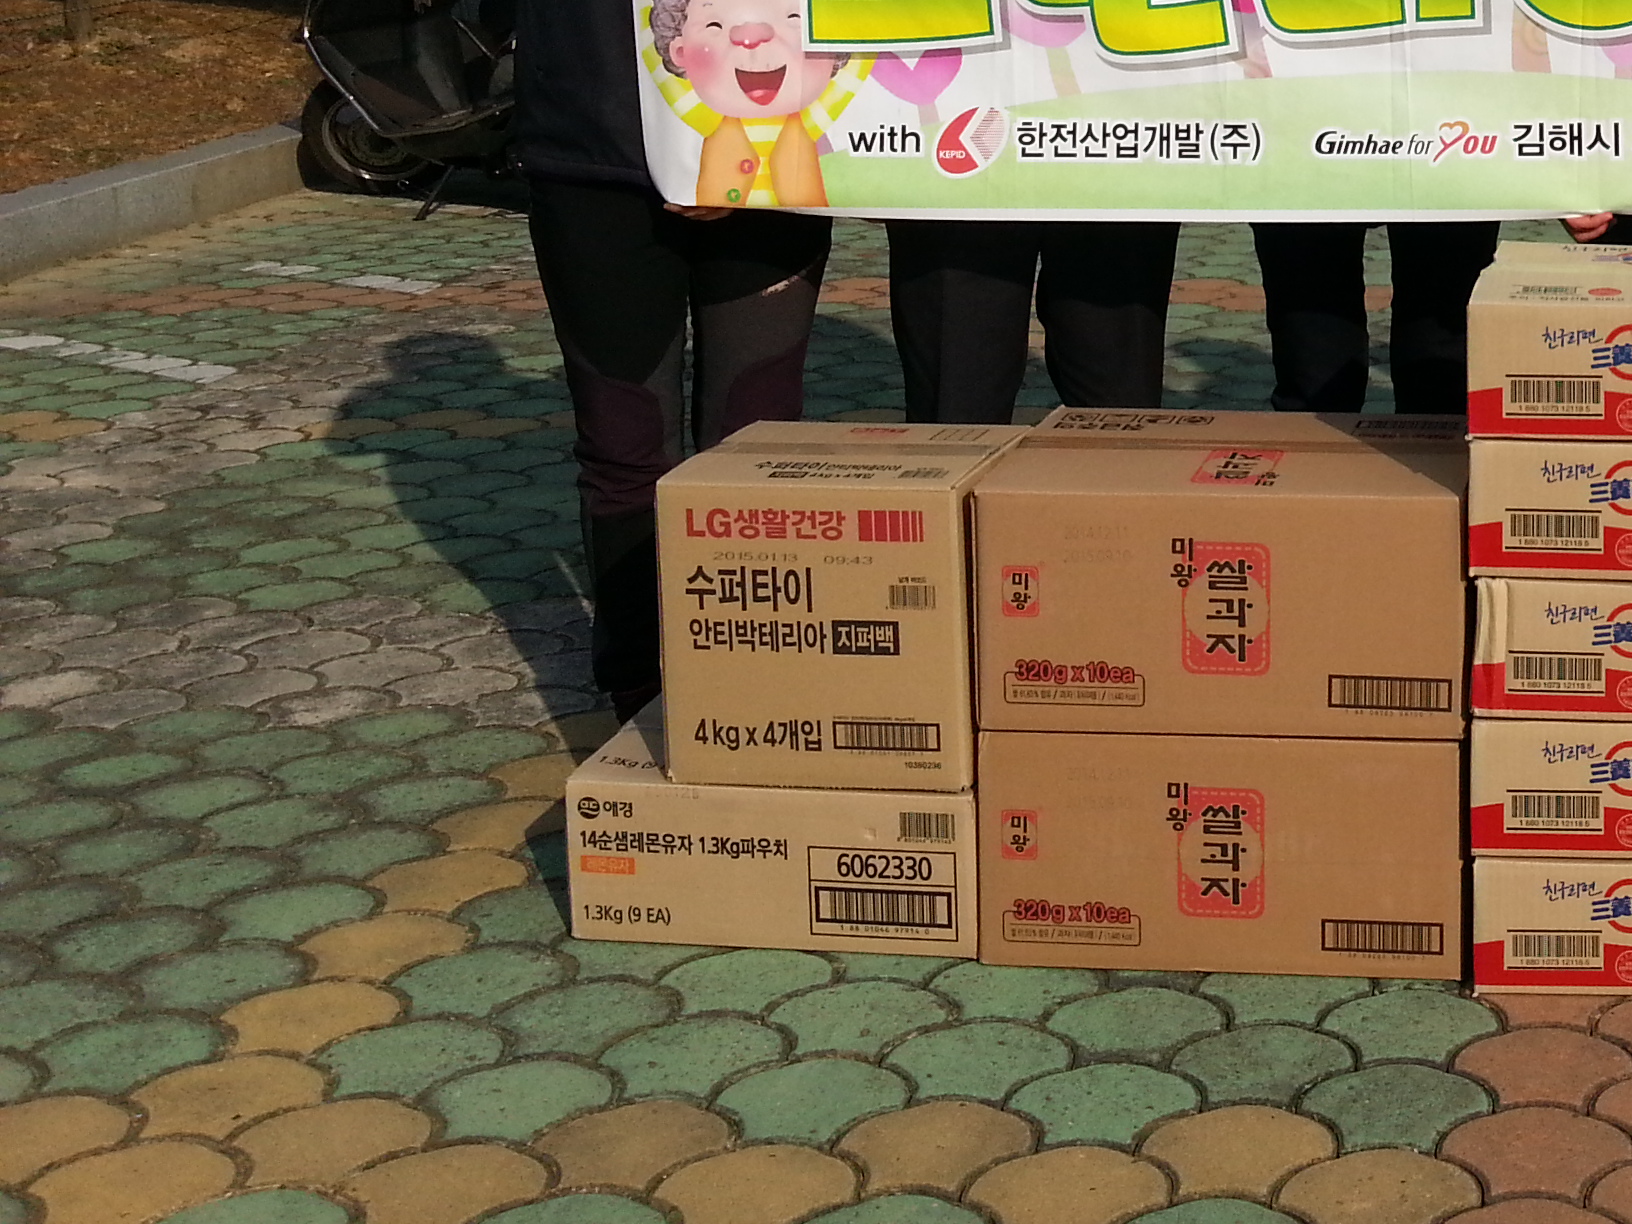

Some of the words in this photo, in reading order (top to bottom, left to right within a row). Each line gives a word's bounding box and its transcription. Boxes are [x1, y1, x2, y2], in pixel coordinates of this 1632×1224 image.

[848, 125, 921, 154] with
[939, 150, 966, 159] KEPID
[1016, 122, 1204, 160] 한전산업개발
[1209, 122, 1261, 162] (주)
[1315, 130, 1403, 157] Gimhae
[1407, 133, 1434, 156] for
[1511, 121, 1622, 157] 김해시
[685, 507, 846, 541] LG생활건강
[823, 554, 874, 566] 09:43
[1170, 538, 1197, 589] 미왕
[685, 565, 814, 613] 수퍼타이
[1011, 572, 1032, 611] 미왕
[1206, 559, 1253, 662] 쌀과자
[688, 618, 827, 654] 안티박테리아
[837, 624, 896, 653] 지퍼백
[694, 718, 740, 751] 4kg
[762, 719, 823, 752] 4개입
[603, 800, 633, 818] 애경
[1166, 782, 1193, 832] 미왕
[580, 830, 694, 857] 14순샘레몬유자
[698, 836, 789, 861] 1.3Kg파우치
[1010, 816, 1030, 853] 미왕
[836, 853, 933, 881] 6062330
[1200, 804, 1248, 906] 쌀과자
[584, 904, 624, 925] 1.3Kg
[645, 907, 672, 928] EA)
